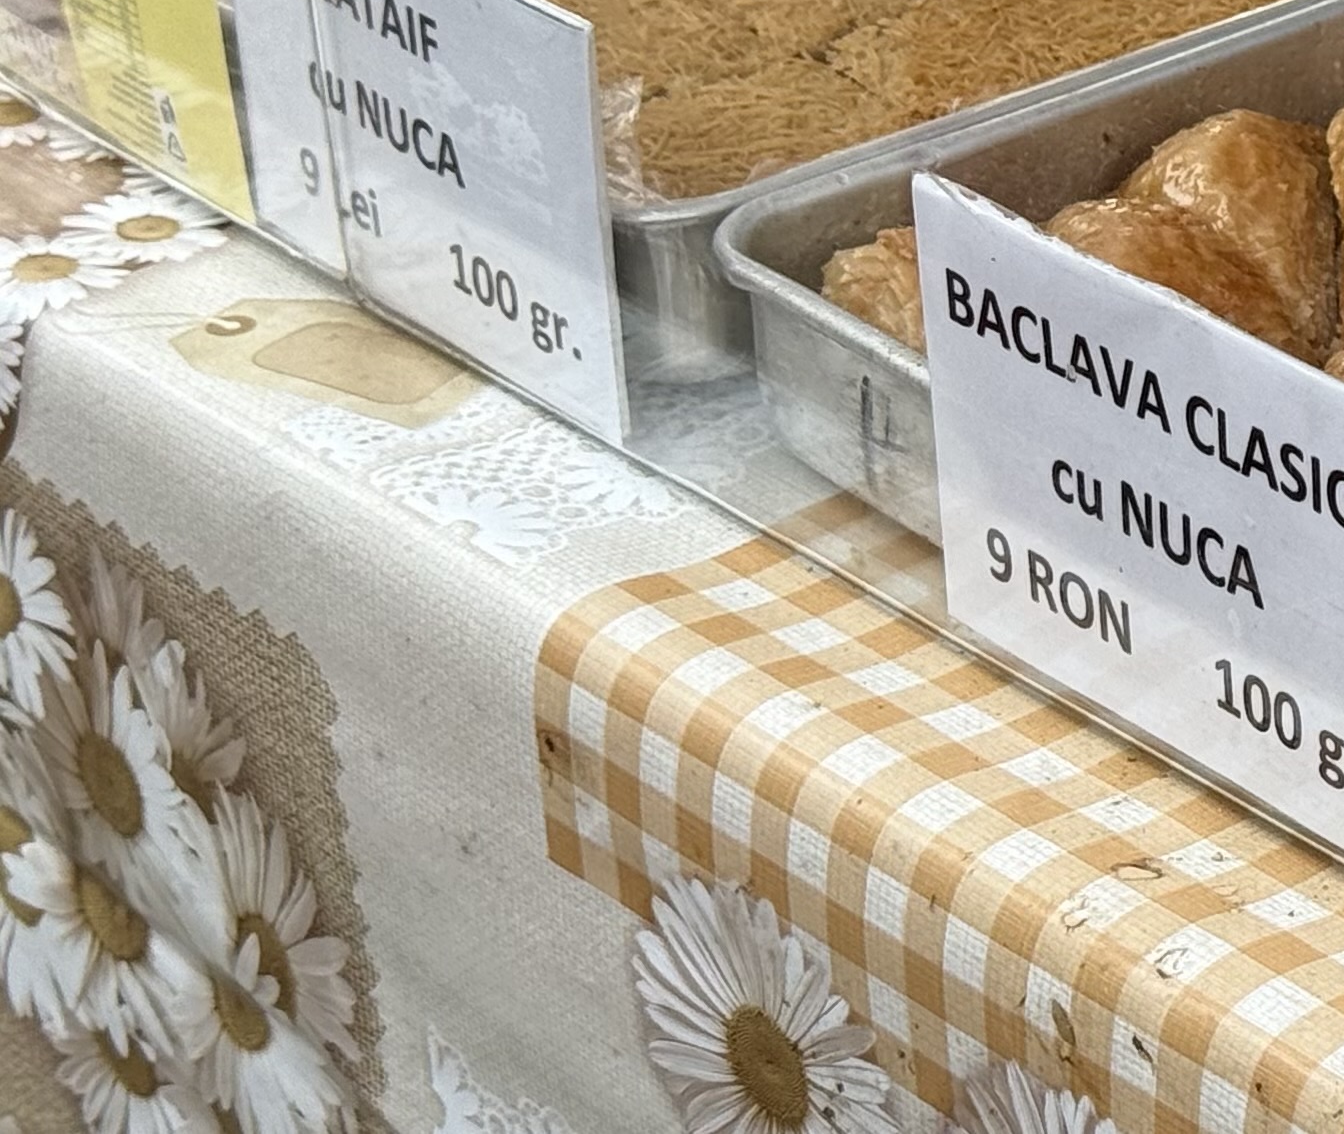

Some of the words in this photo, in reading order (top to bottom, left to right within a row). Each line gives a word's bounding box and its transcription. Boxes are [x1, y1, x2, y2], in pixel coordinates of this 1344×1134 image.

[355, 80, 466, 189] NUCA
[299, 147, 321, 197] 9
[449, 244, 518, 321] 100
[531, 302, 583, 360] gr.
[946, 268, 1172, 435] BACLAVA
[1052, 459, 1104, 522] cu
[1121, 480, 1264, 611] NUCA
[986, 528, 1013, 584] 9
[1028, 549, 1133, 656] RON
[1215, 659, 1303, 751] 100
